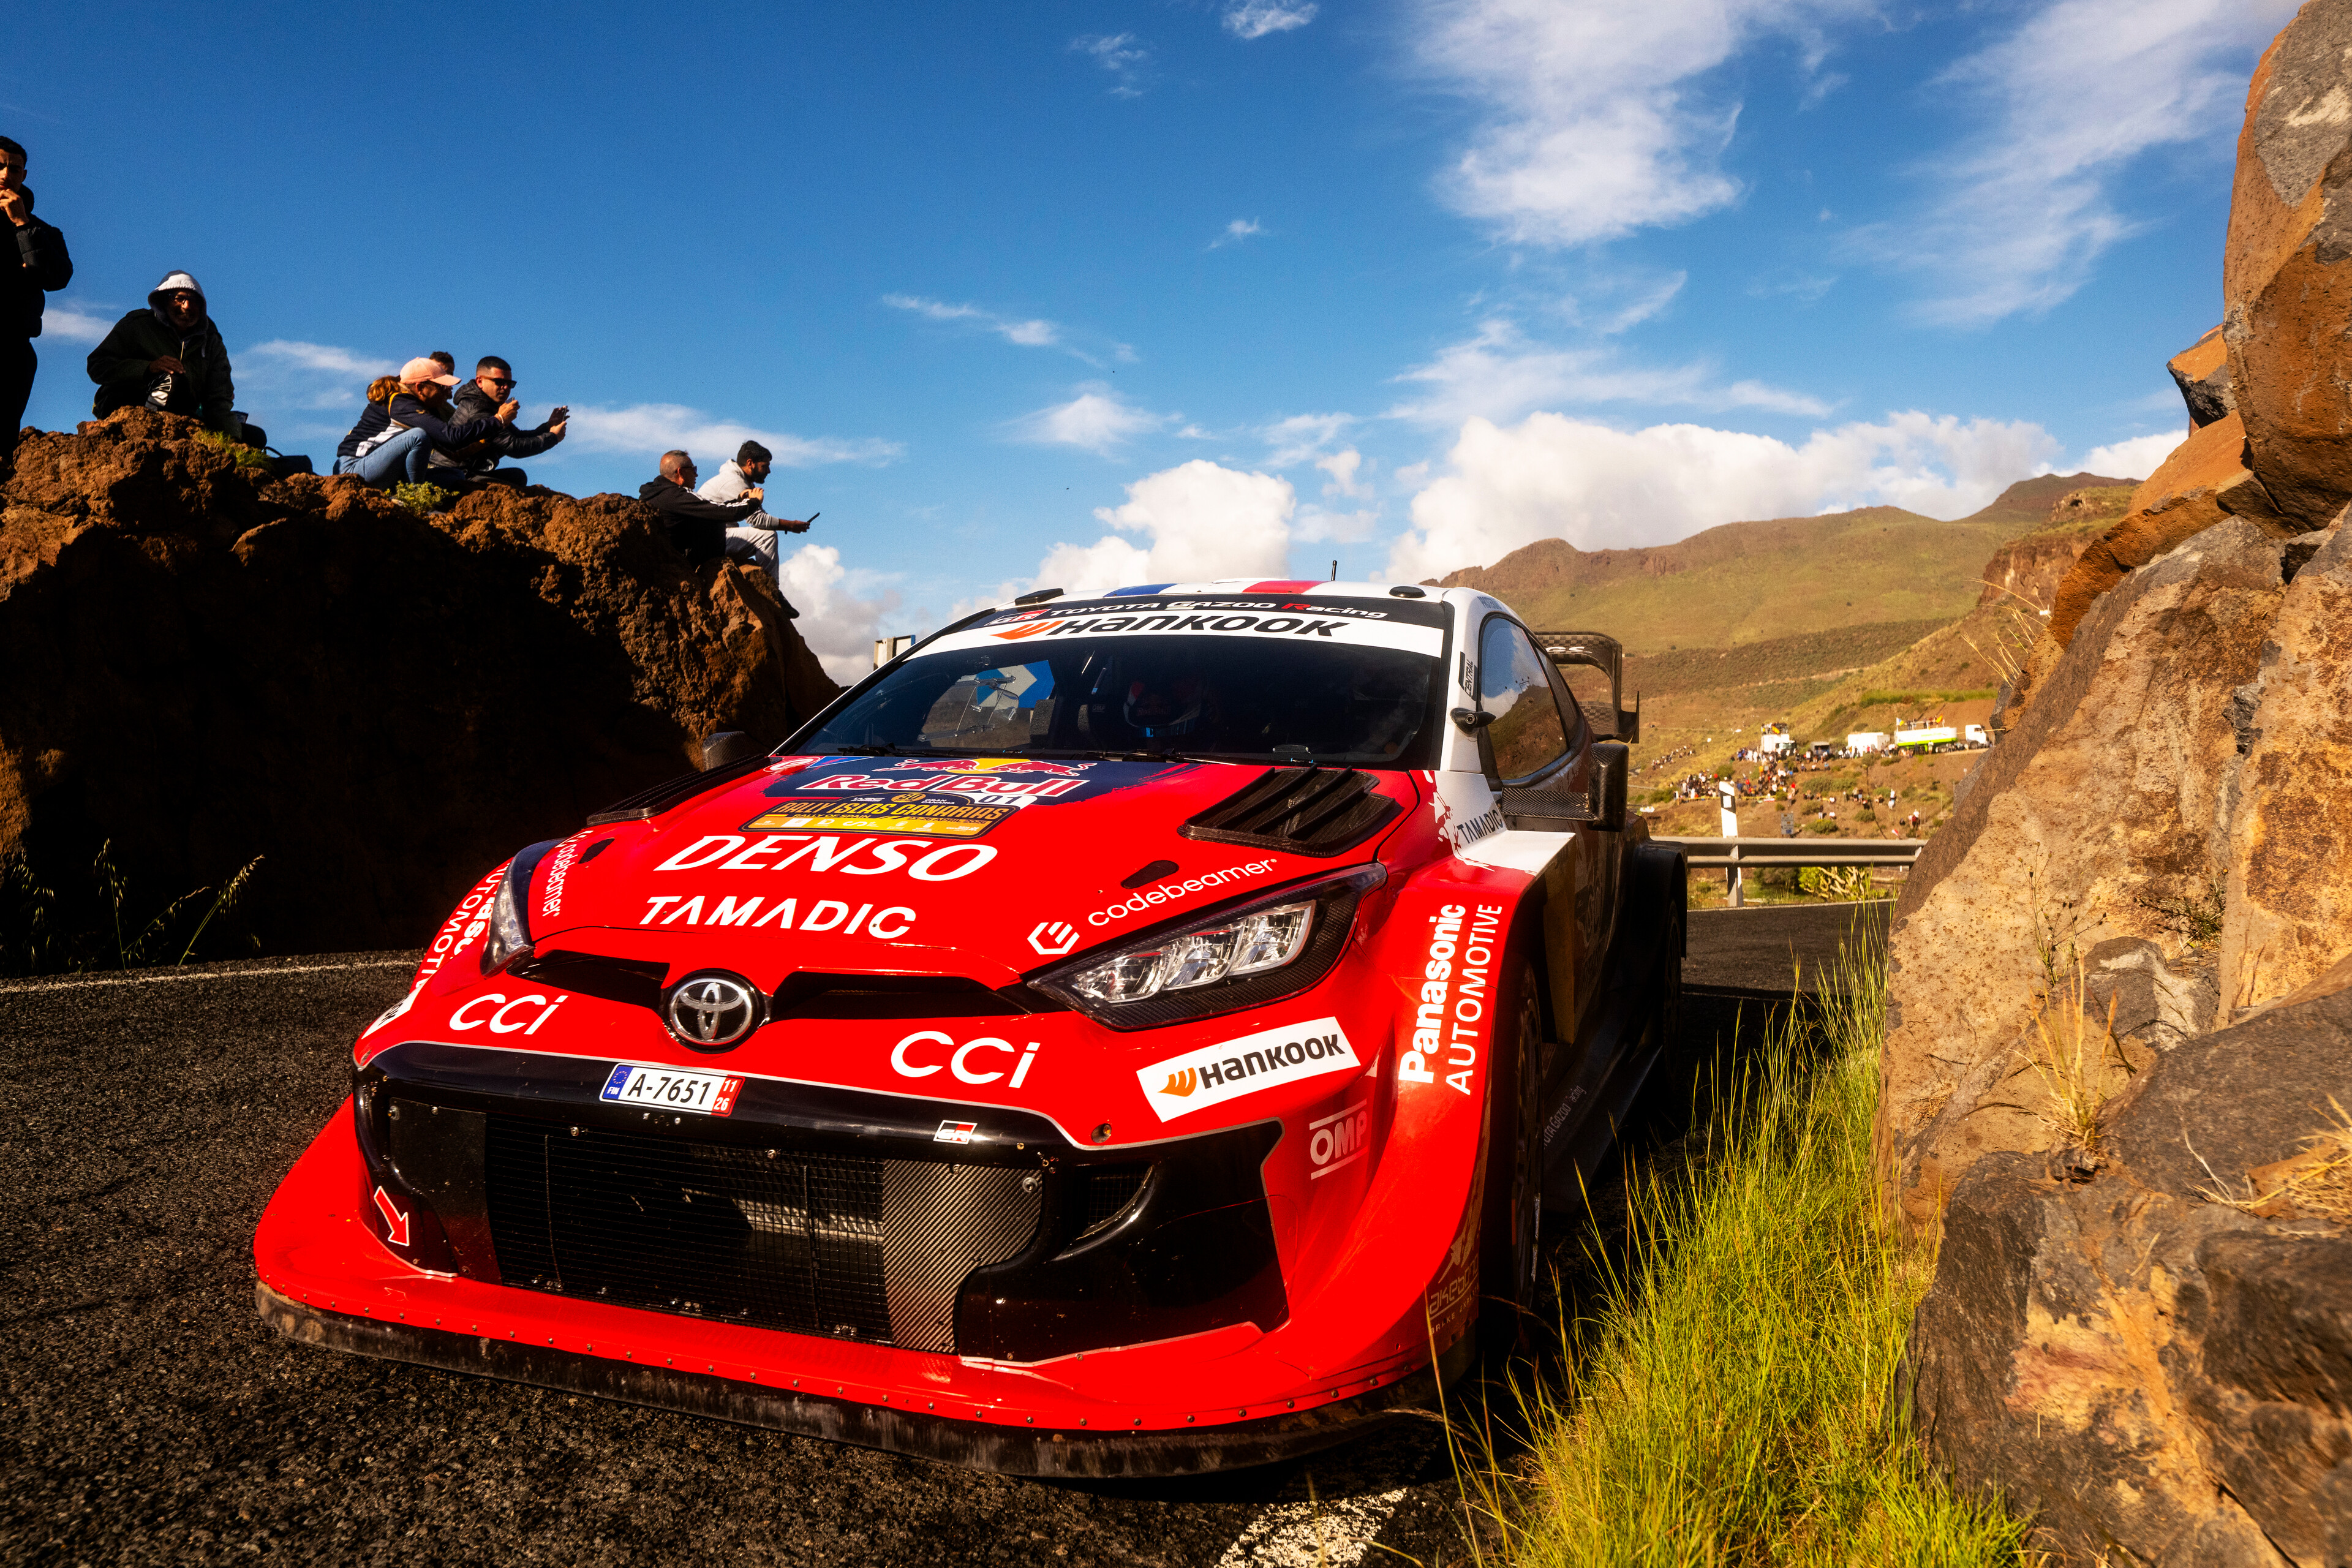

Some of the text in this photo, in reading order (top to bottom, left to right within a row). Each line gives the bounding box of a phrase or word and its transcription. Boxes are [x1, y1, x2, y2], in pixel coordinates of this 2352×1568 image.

[1050, 601, 1389, 619] TOYOTA GAZOO Racing
[1464, 659, 1473, 698] CENTRAL
[796, 774, 1090, 797] Red Bull
[771, 802, 1009, 820] RALLY ISLAS CANARIAS
[1457, 809, 1503, 844] TAMADIC
[652, 835, 998, 881] DENSO
[639, 895, 917, 939] TAMADIC
[1398, 903, 1466, 1084] Panasonic
[1446, 903, 1502, 1095] AUTOMOTIVE
[607, 1087, 620, 1095] FIN
[627, 1074, 711, 1105] A-7651
[723, 1079, 737, 1093] 11
[714, 1097, 730, 1111] 26
[1549, 1102, 1572, 1129] GAZOO
[1310, 1110, 1367, 1165] OMP
